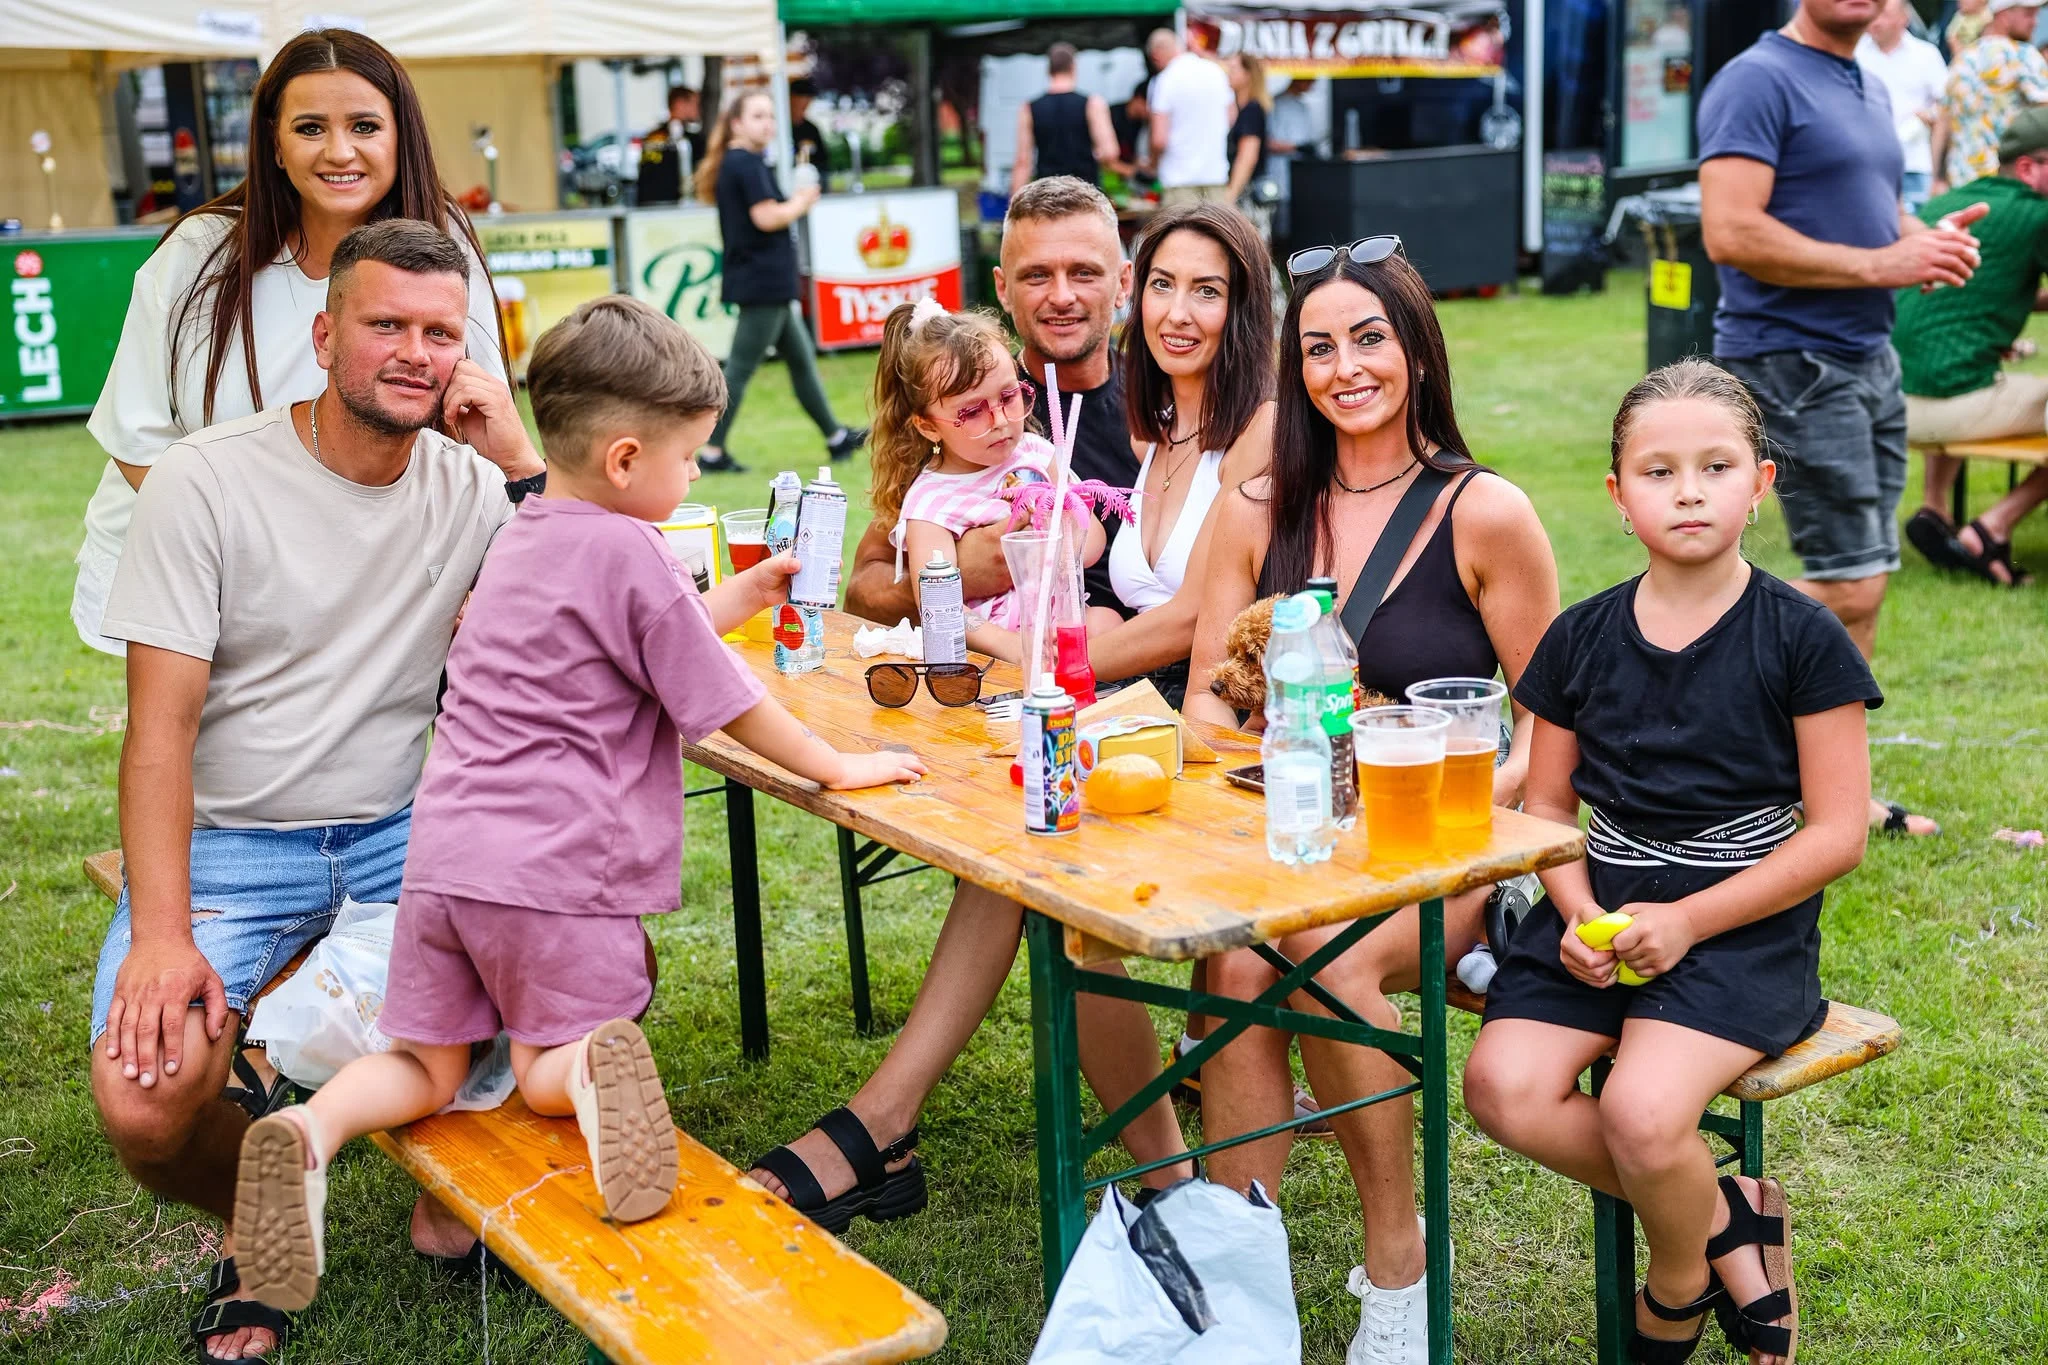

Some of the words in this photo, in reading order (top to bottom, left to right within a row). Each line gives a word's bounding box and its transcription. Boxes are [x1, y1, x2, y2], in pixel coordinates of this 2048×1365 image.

[1217, 19, 1310, 59] DANIA
[1311, 21, 1338, 59] Z
[1335, 18, 1449, 60] GRILLA
[11, 276, 63, 403] LECH
[1757, 808, 1782, 827] ACTIVE
[1649, 839, 1683, 855] ACTIVE
[1713, 849, 1746, 859] ACTIVE
